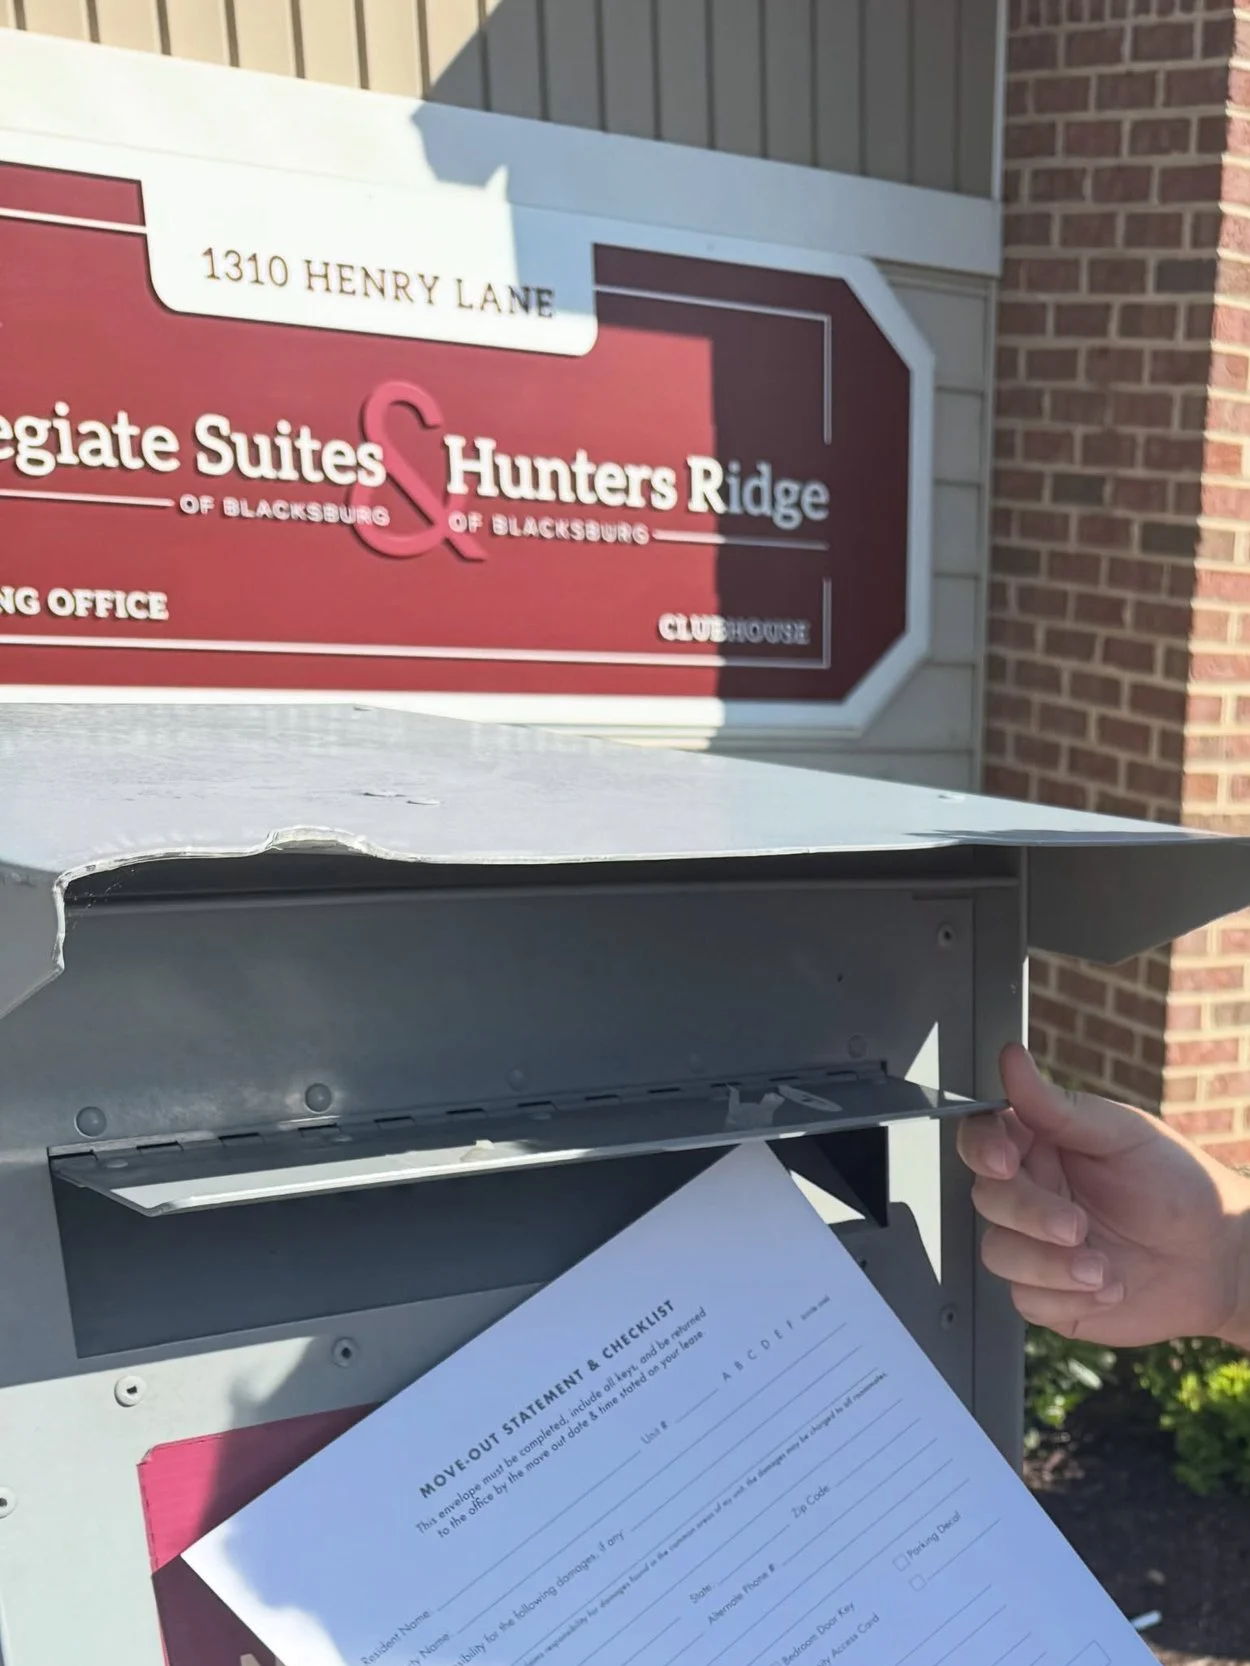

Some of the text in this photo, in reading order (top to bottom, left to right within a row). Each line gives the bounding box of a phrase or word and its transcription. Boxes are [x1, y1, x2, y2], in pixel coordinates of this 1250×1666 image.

[201, 246, 556, 320] 1310 HENRY LANE
[193, 413, 386, 488] Suites
[443, 433, 679, 513] Hunters
[686, 454, 830, 530] Ridge
[178, 493, 391, 527] OF BLACKSBURG
[448, 510, 650, 546] OF BLACKSBURG
[47, 587, 169, 621] OFFICE
[657, 612, 812, 646] CLUBHOUSE
[720, 1370, 732, 1382] A
[732, 1359, 744, 1372] B
[745, 1347, 759, 1361] C
[758, 1337, 771, 1351] D
[772, 1327, 784, 1340] E
[414, 1516, 438, 1534] This
[437, 1482, 482, 1519] envelope
[481, 1462, 505, 1486] must
[501, 1454, 519, 1468] be
[518, 1413, 570, 1457] completed,
[569, 1389, 603, 1418] include
[602, 1375, 617, 1393] all
[638, 1343, 659, 1365] and
[654, 1337, 671, 1351] be
[669, 1305, 707, 1340] returned
[418, 1298, 674, 1499] MOVE-OUT STATEMENT & CHECKLIST
[436, 1526, 451, 1539] to
[448, 1513, 468, 1529] the
[467, 1492, 495, 1516] office
[491, 1481, 509, 1496] by
[506, 1468, 525, 1485] the
[524, 1449, 550, 1472] move
[549, 1433, 567, 1452] out
[566, 1418, 590, 1439] date
[587, 1409, 599, 1422] &
[596, 1395, 619, 1415] time
[618, 1370, 648, 1399] stated
[646, 1363, 661, 1378] on
[658, 1347, 680, 1370] your
[790, 1503, 808, 1520] Zip
[905, 1509, 962, 1559] Parking Decal
[482, 1630, 500, 1644] for
[497, 1617, 516, 1632] the
[511, 1585, 559, 1620] following
[706, 1592, 744, 1626] Alternate
[740, 1570, 770, 1595] Phone
[359, 1632, 401, 1666] Resident
[780, 1601, 856, 1666] Bedroom Door Key
[830, 1632, 859, 1659] Access
[855, 1611, 881, 1635] Card
